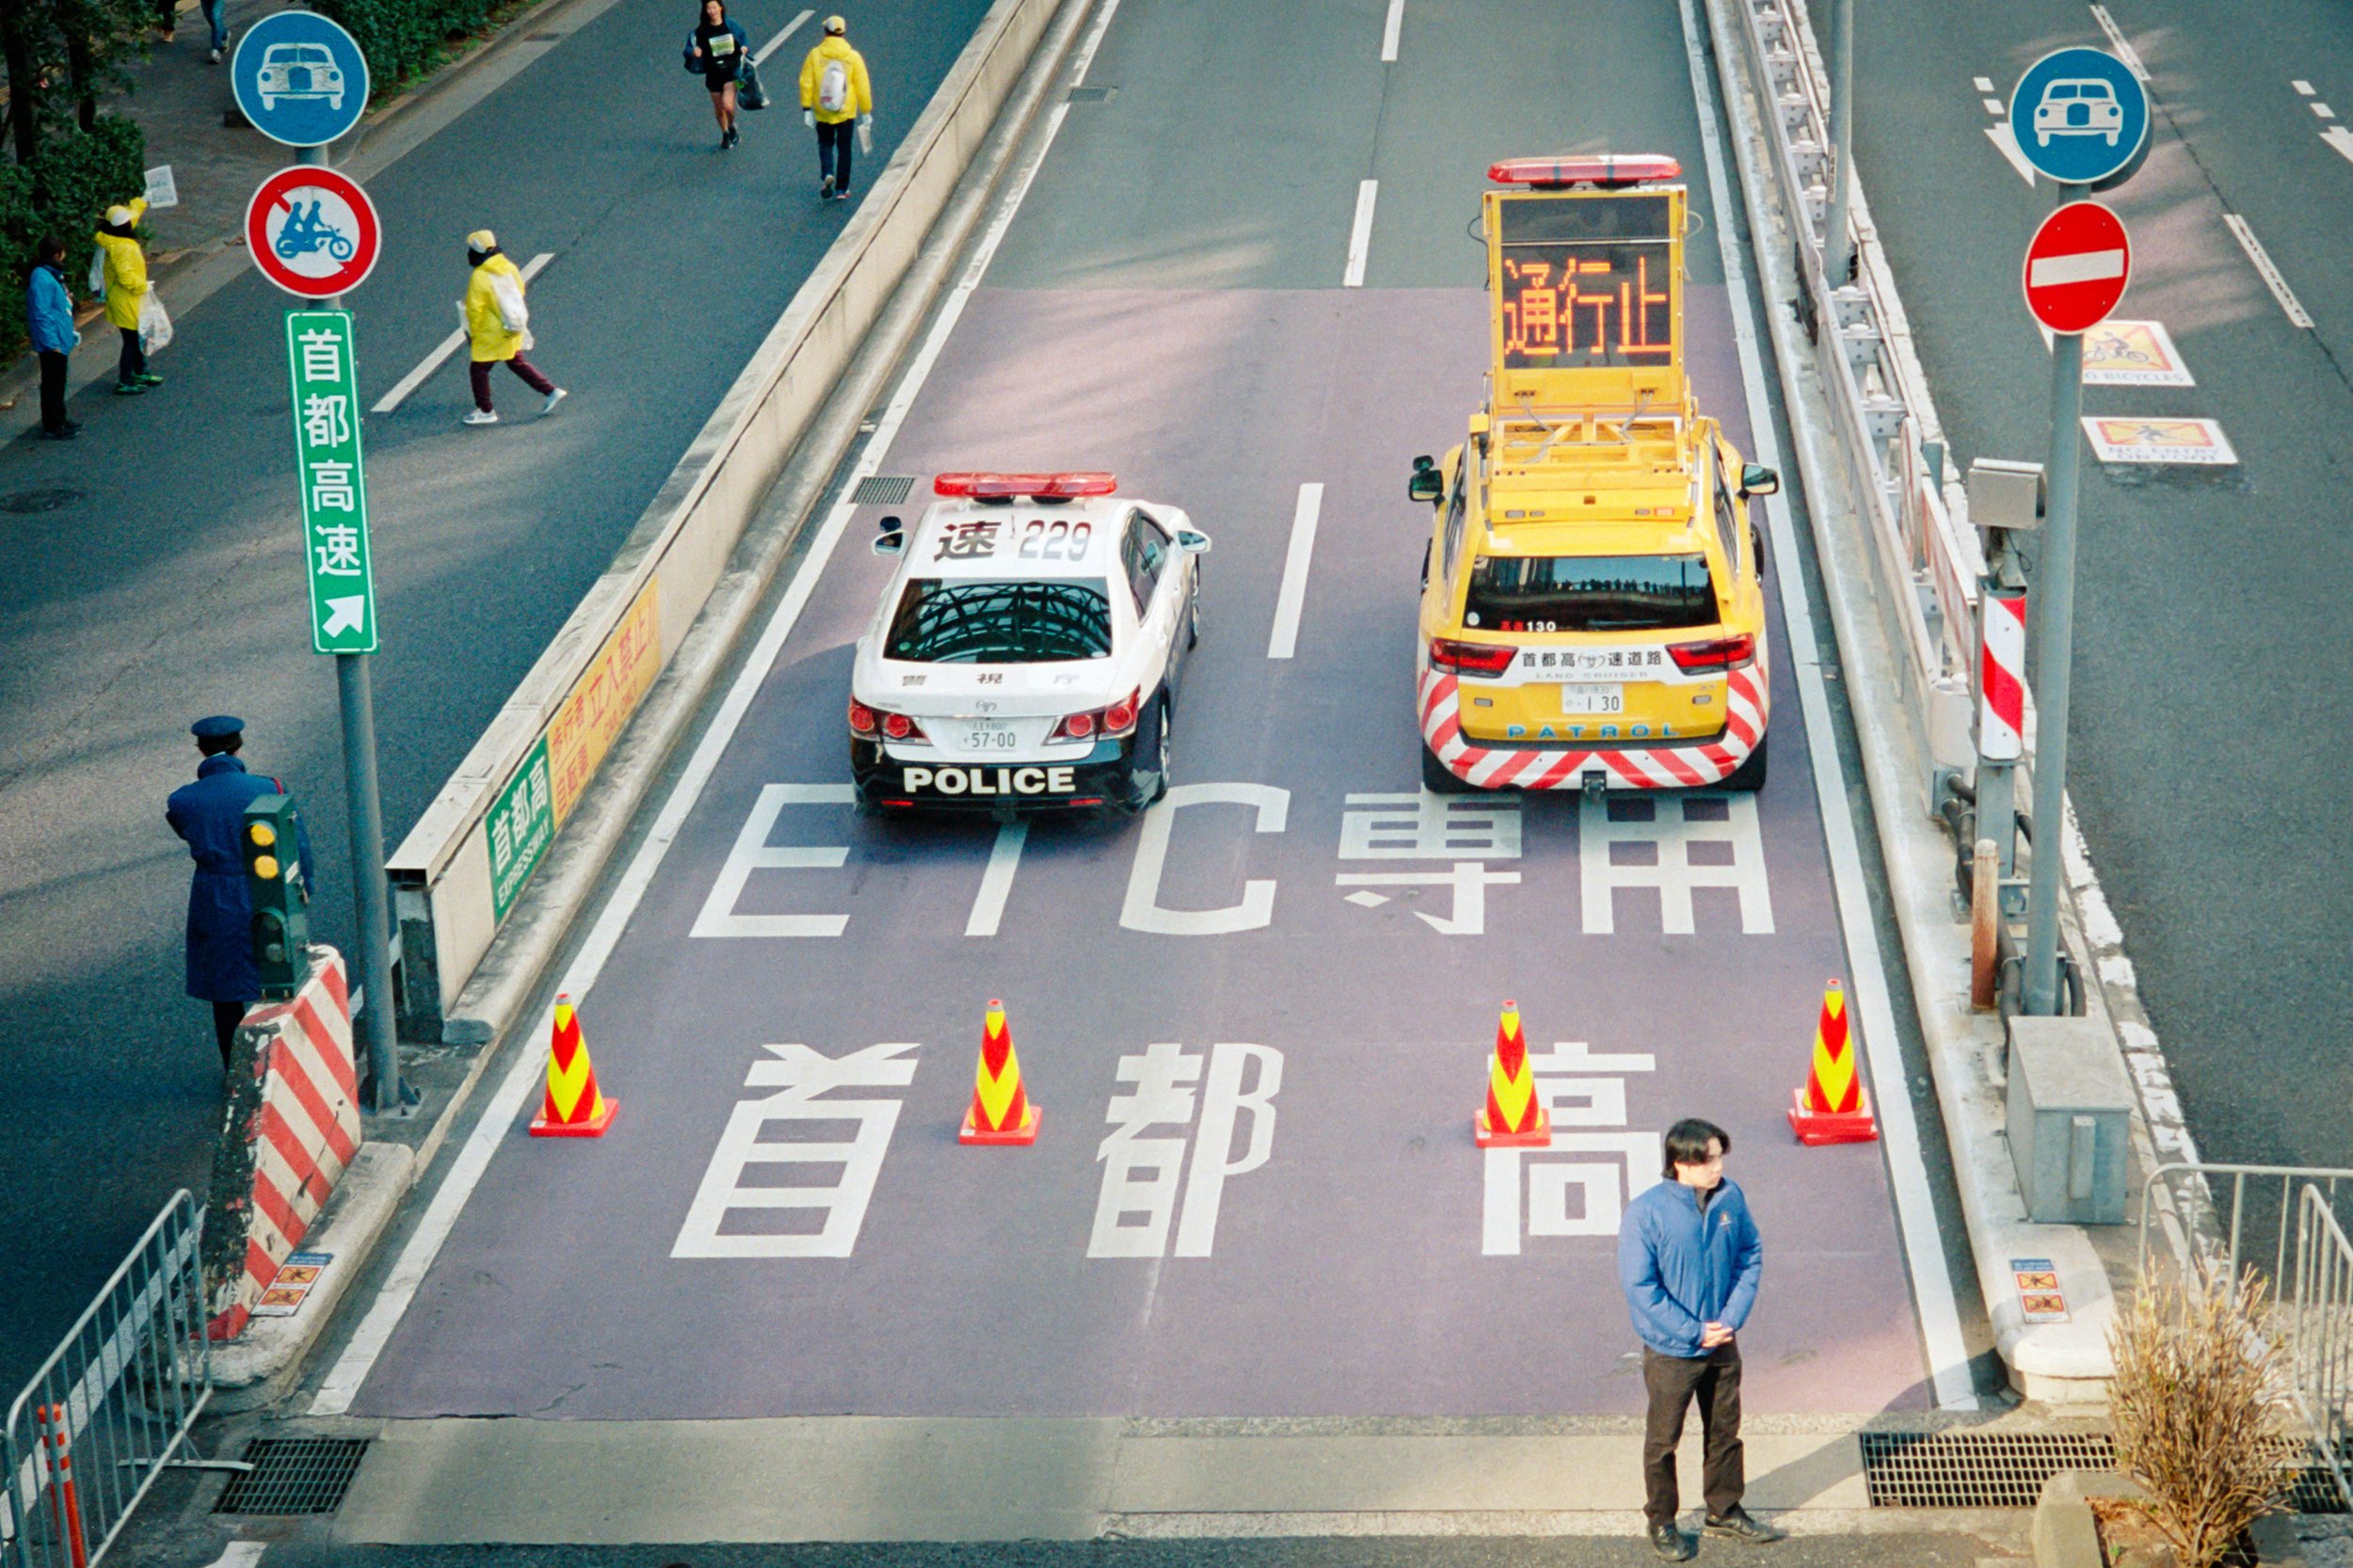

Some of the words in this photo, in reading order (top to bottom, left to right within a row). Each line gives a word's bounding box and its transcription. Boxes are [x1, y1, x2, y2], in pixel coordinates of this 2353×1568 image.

[1503, 256, 1671, 356] 通行止
[297, 328, 362, 577] 首都高速
[1018, 520, 1092, 561] 229
[904, 766, 1076, 794] POLICE
[1507, 723, 1680, 739] PATROL
[491, 755, 549, 876] 首都高
[669, 1041, 1665, 1257] 首都高
